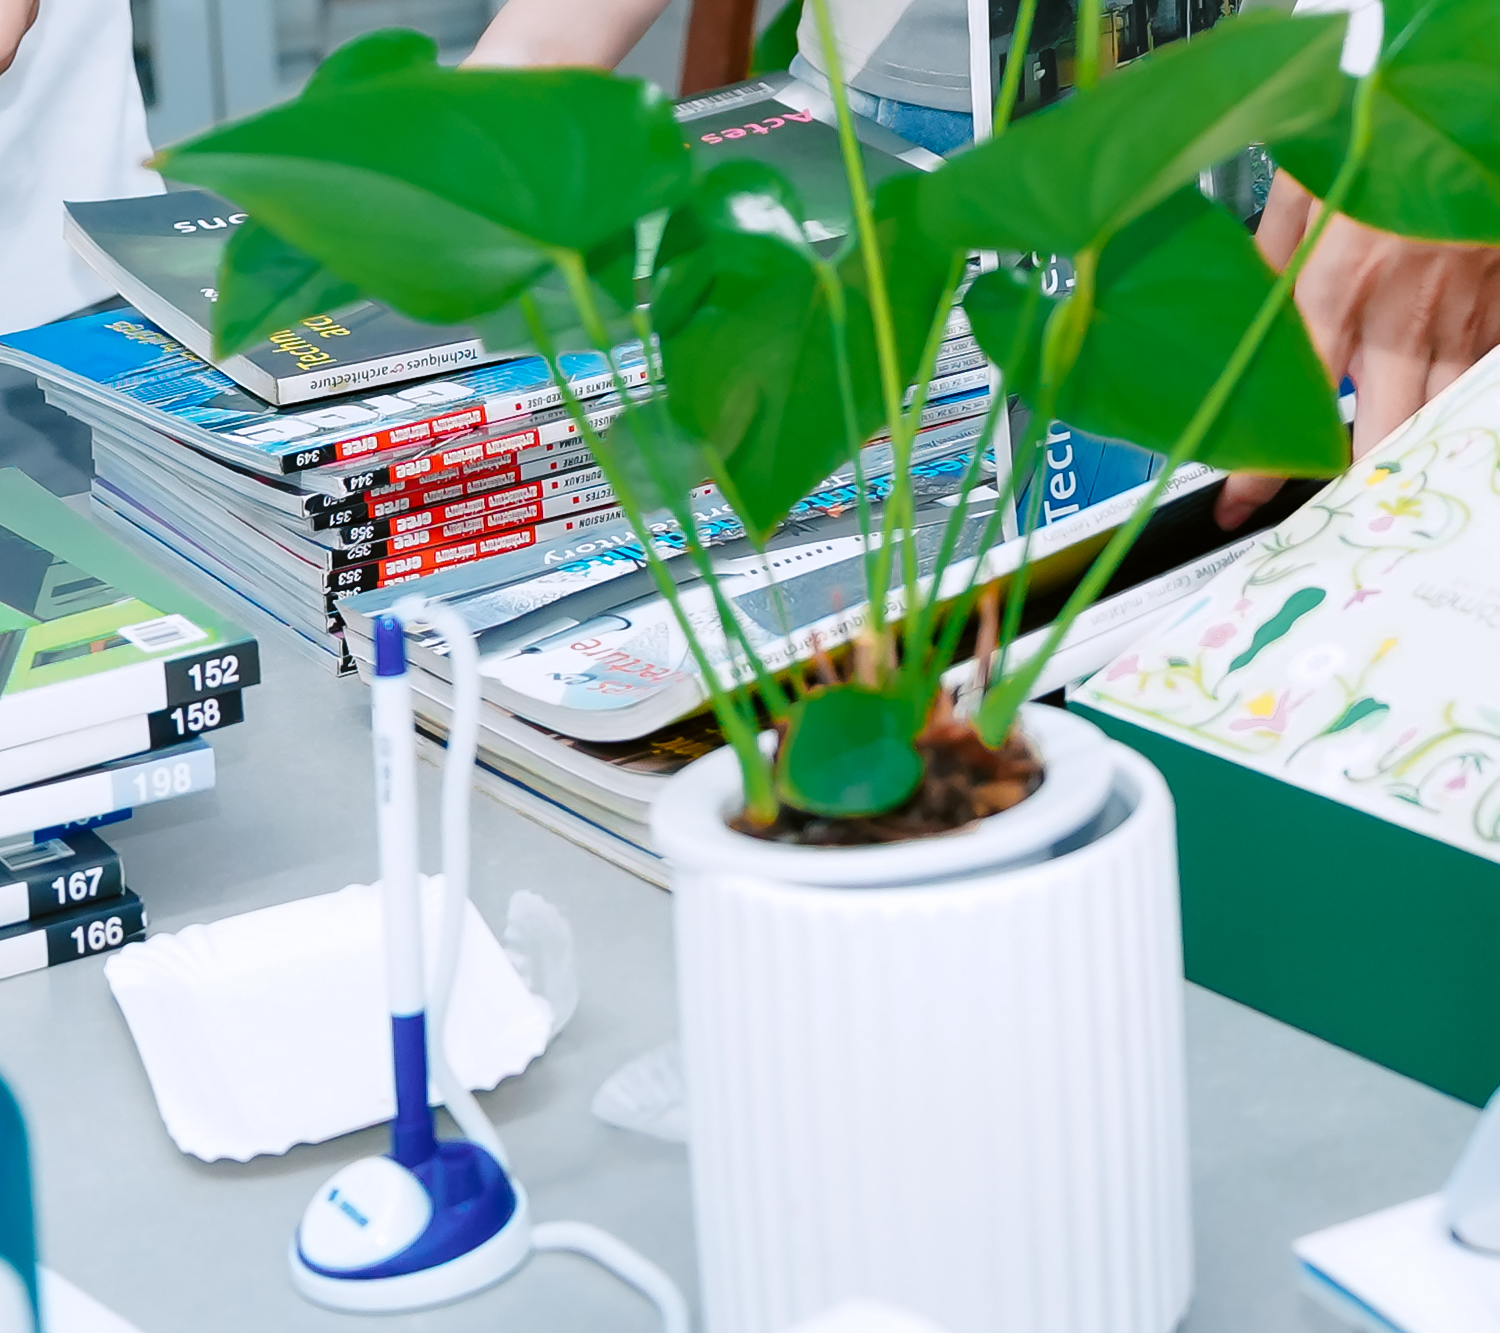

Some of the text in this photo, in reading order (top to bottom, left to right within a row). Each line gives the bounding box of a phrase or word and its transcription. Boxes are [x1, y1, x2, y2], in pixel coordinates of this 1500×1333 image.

[701, 108, 812, 146] Actes
[309, 365, 389, 392] architecture
[407, 348, 478, 373] Techniques
[562, 452, 595, 469] ULTURE
[585, 487, 615, 502] TECTES
[578, 509, 627, 529] ONVERSION
[187, 655, 240, 691] 152
[170, 699, 221, 735] 158
[132, 762, 193, 801] 198
[52, 866, 104, 904] 167
[71, 917, 123, 954] 166
